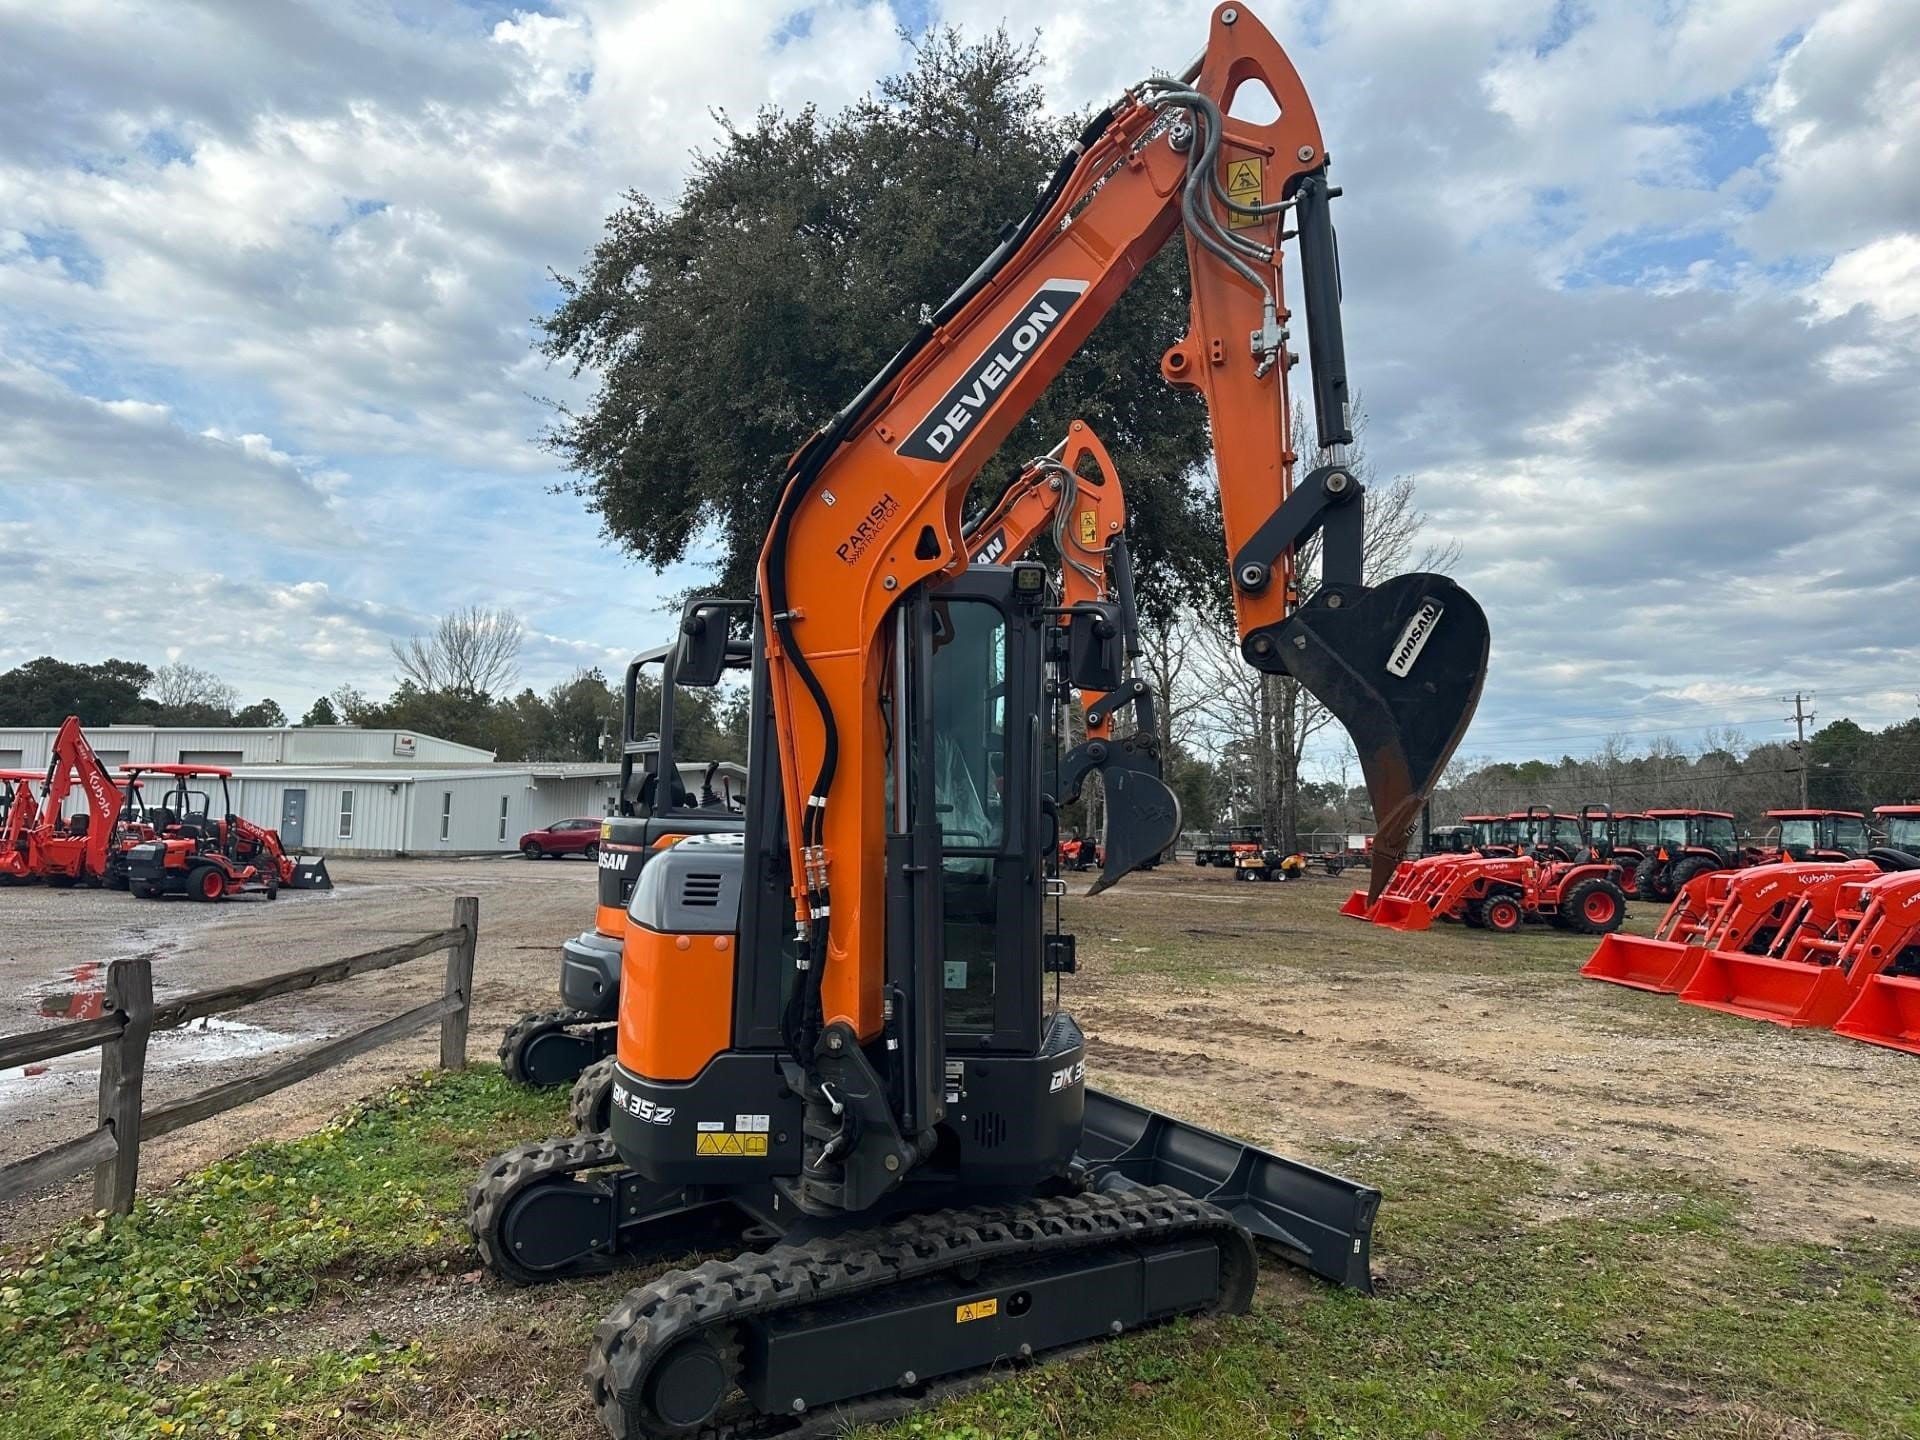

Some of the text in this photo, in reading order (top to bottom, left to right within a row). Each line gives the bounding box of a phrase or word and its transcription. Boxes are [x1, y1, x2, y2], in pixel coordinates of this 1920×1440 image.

[926, 301, 1059, 454] DEVELON
[836, 493, 894, 561] PARISH
[860, 502, 901, 548] TRACTOR
[1394, 606, 1434, 670] DOOSAN
[89, 770, 111, 818] Kubota
[1799, 873, 1836, 885] Kubota
